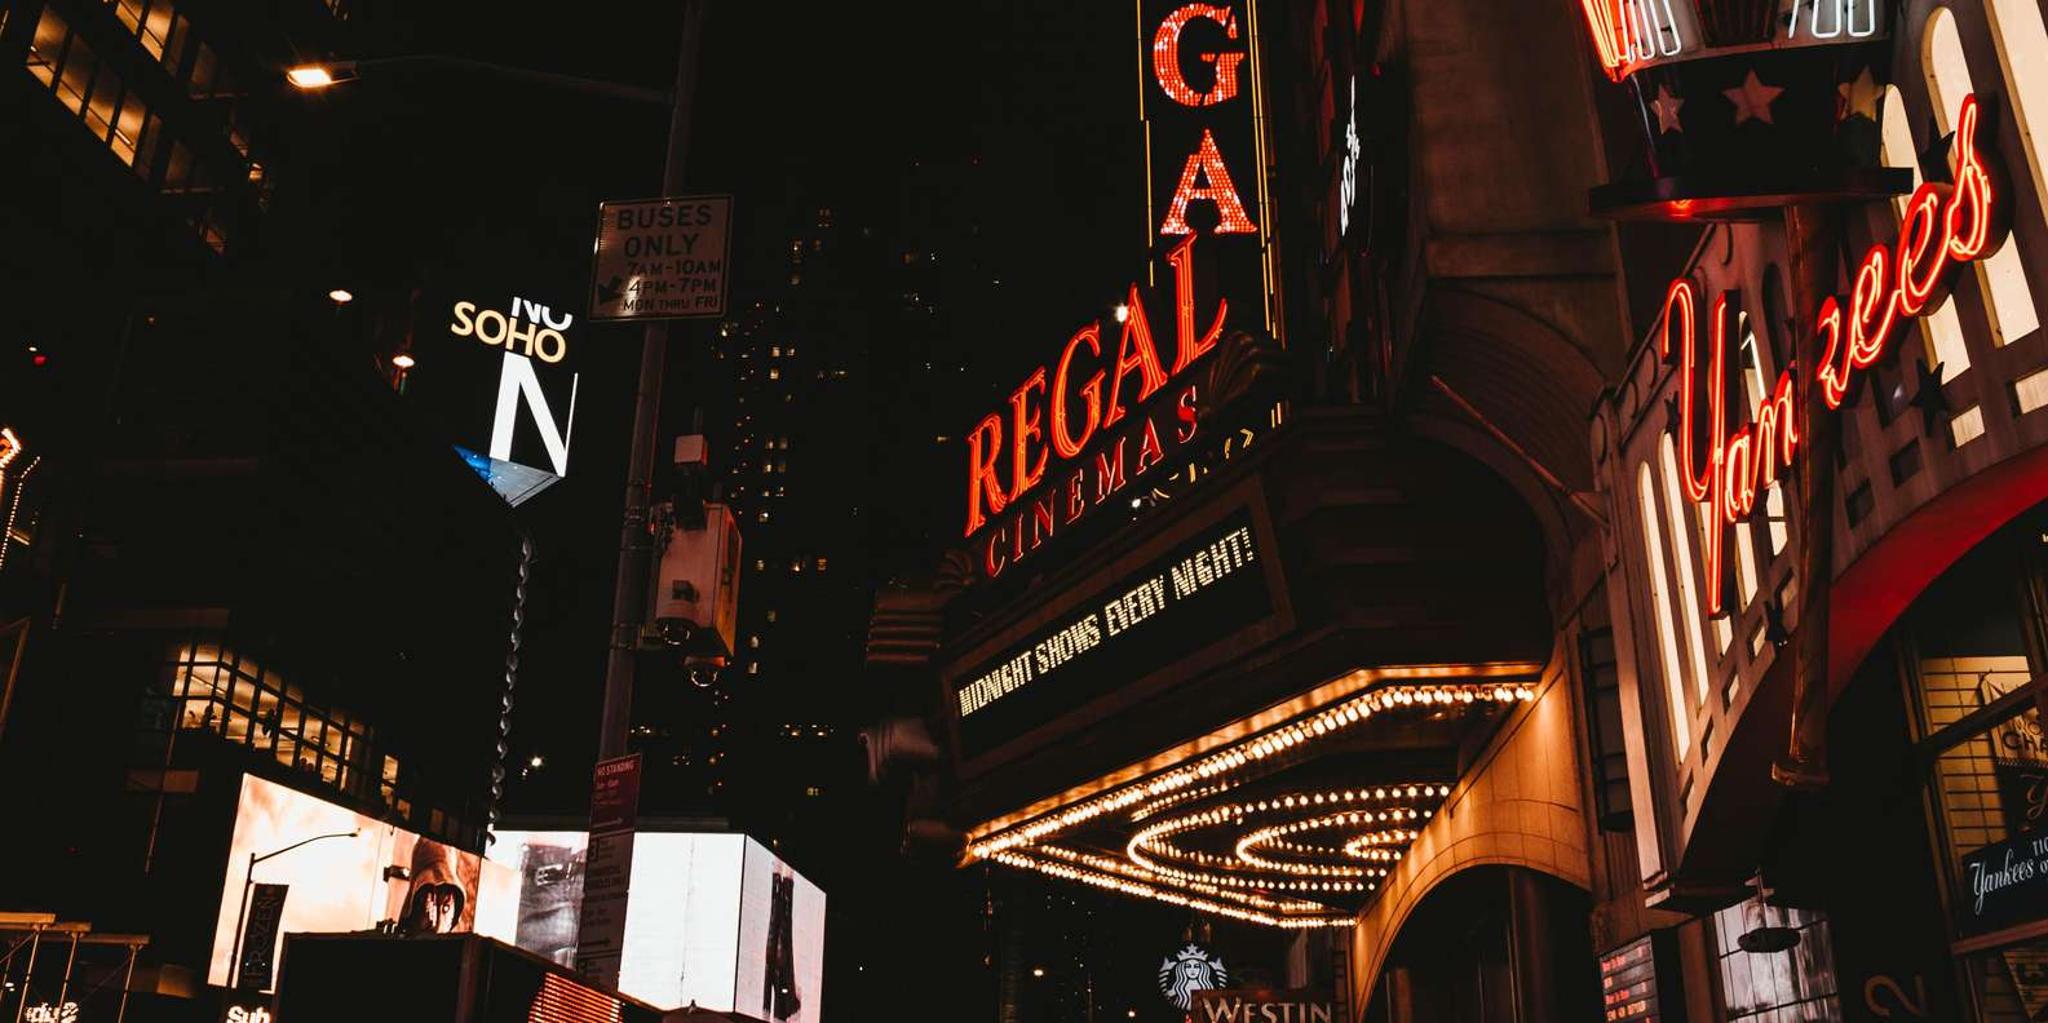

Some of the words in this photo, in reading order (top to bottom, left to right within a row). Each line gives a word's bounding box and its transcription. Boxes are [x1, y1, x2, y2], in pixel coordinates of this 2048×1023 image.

[617, 205, 711, 230] BUSES
[625, 233, 698, 258] ONLY
[627, 260, 720, 276] 7AM-10AM
[629, 278, 716, 295] 4PM-7PM
[623, 299, 654, 311] MON
[659, 299, 690, 309] THRU
[695, 296, 718, 308] FRI
[451, 301, 567, 363] SOHO
[963, 231, 1228, 538] REGAL
[489, 350, 579, 478] N
[985, 384, 1198, 578] CINEMAS
[959, 650, 1033, 717] MIDNIGHT
[1035, 613, 1101, 675] SHOWS
[1104, 574, 1166, 637] EVERY
[1171, 526, 1254, 600] NIGHT!
[1969, 848, 2034, 916] Yankees
[1203, 996, 1332, 1023] WESTIN
